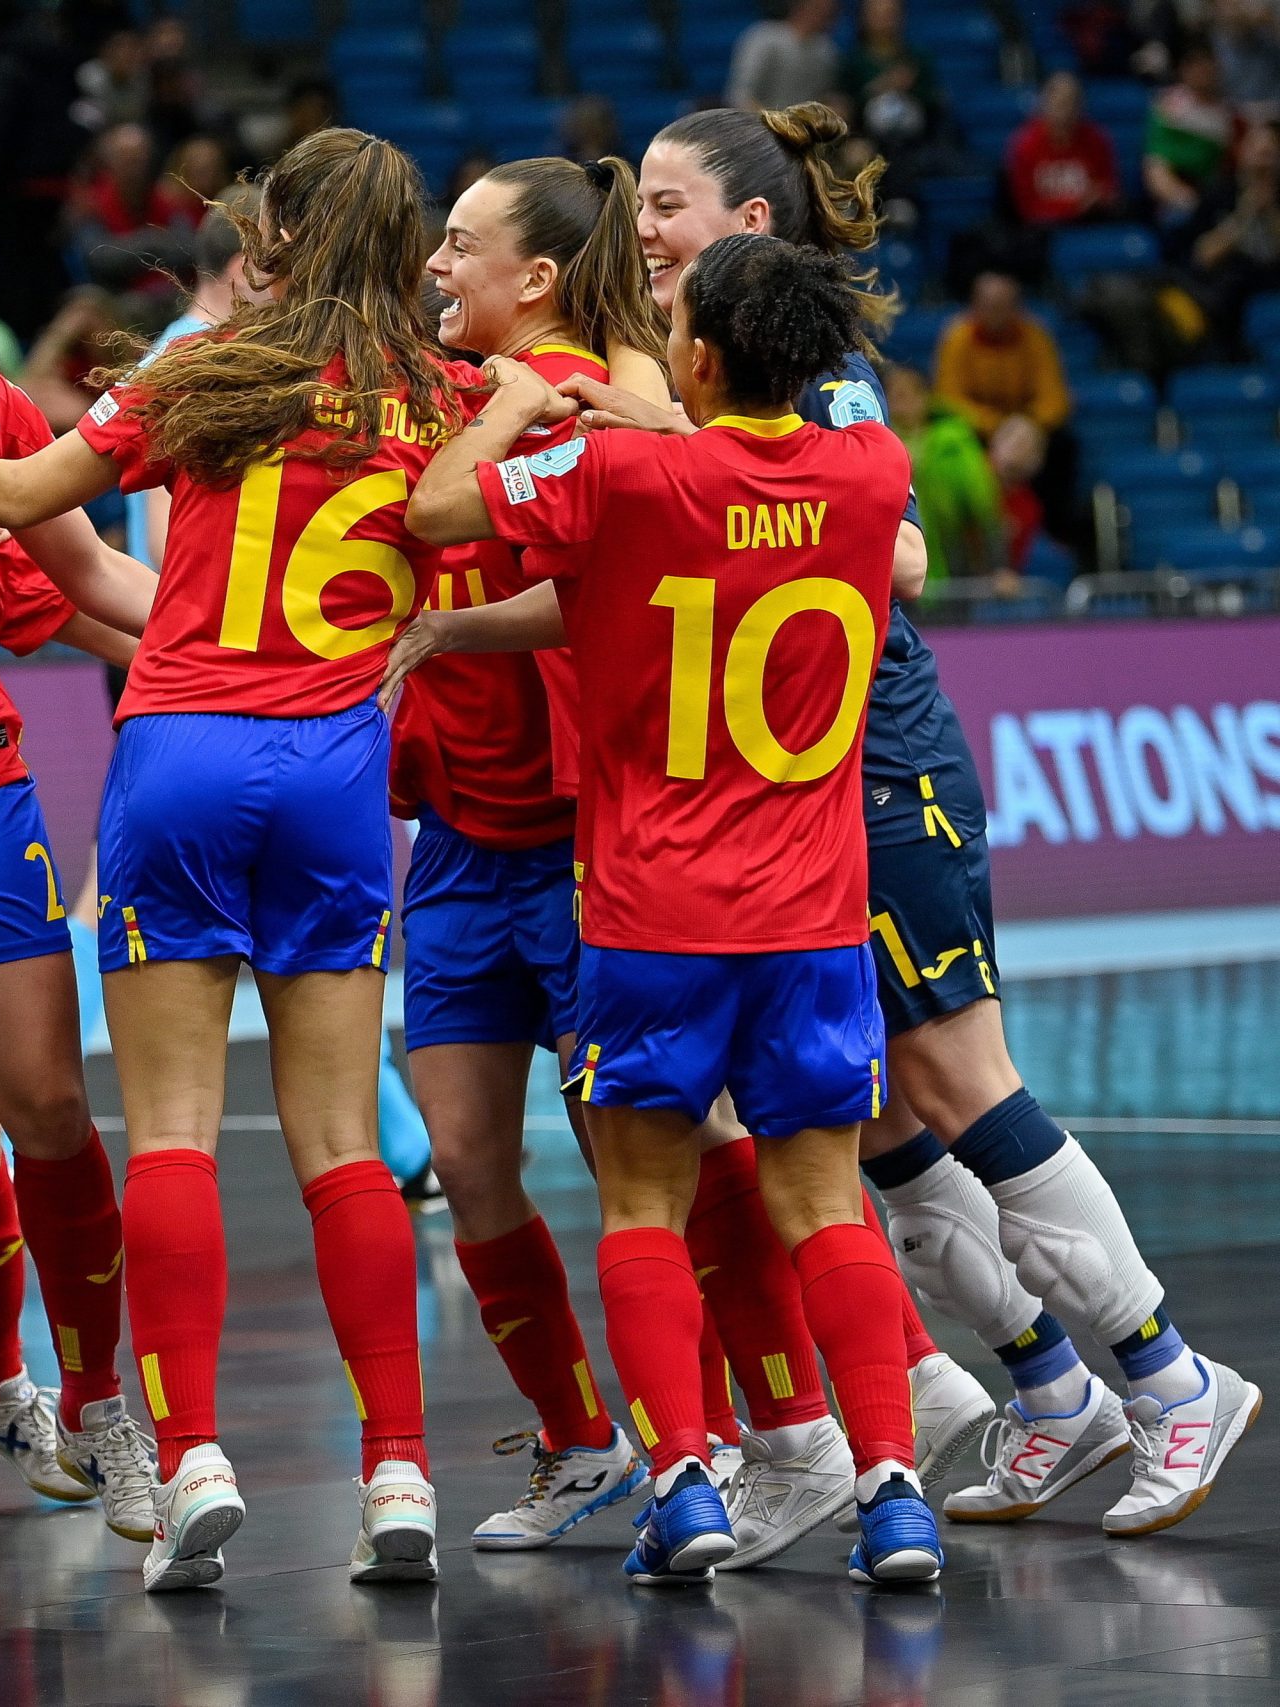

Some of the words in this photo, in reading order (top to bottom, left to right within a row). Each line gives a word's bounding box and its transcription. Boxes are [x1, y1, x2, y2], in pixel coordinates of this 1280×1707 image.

[218, 444, 416, 661] 16
[726, 500, 828, 550] DANY
[648, 575, 876, 784] 10
[985, 699, 1280, 849] ATIONS
[24, 842, 66, 922] 2
